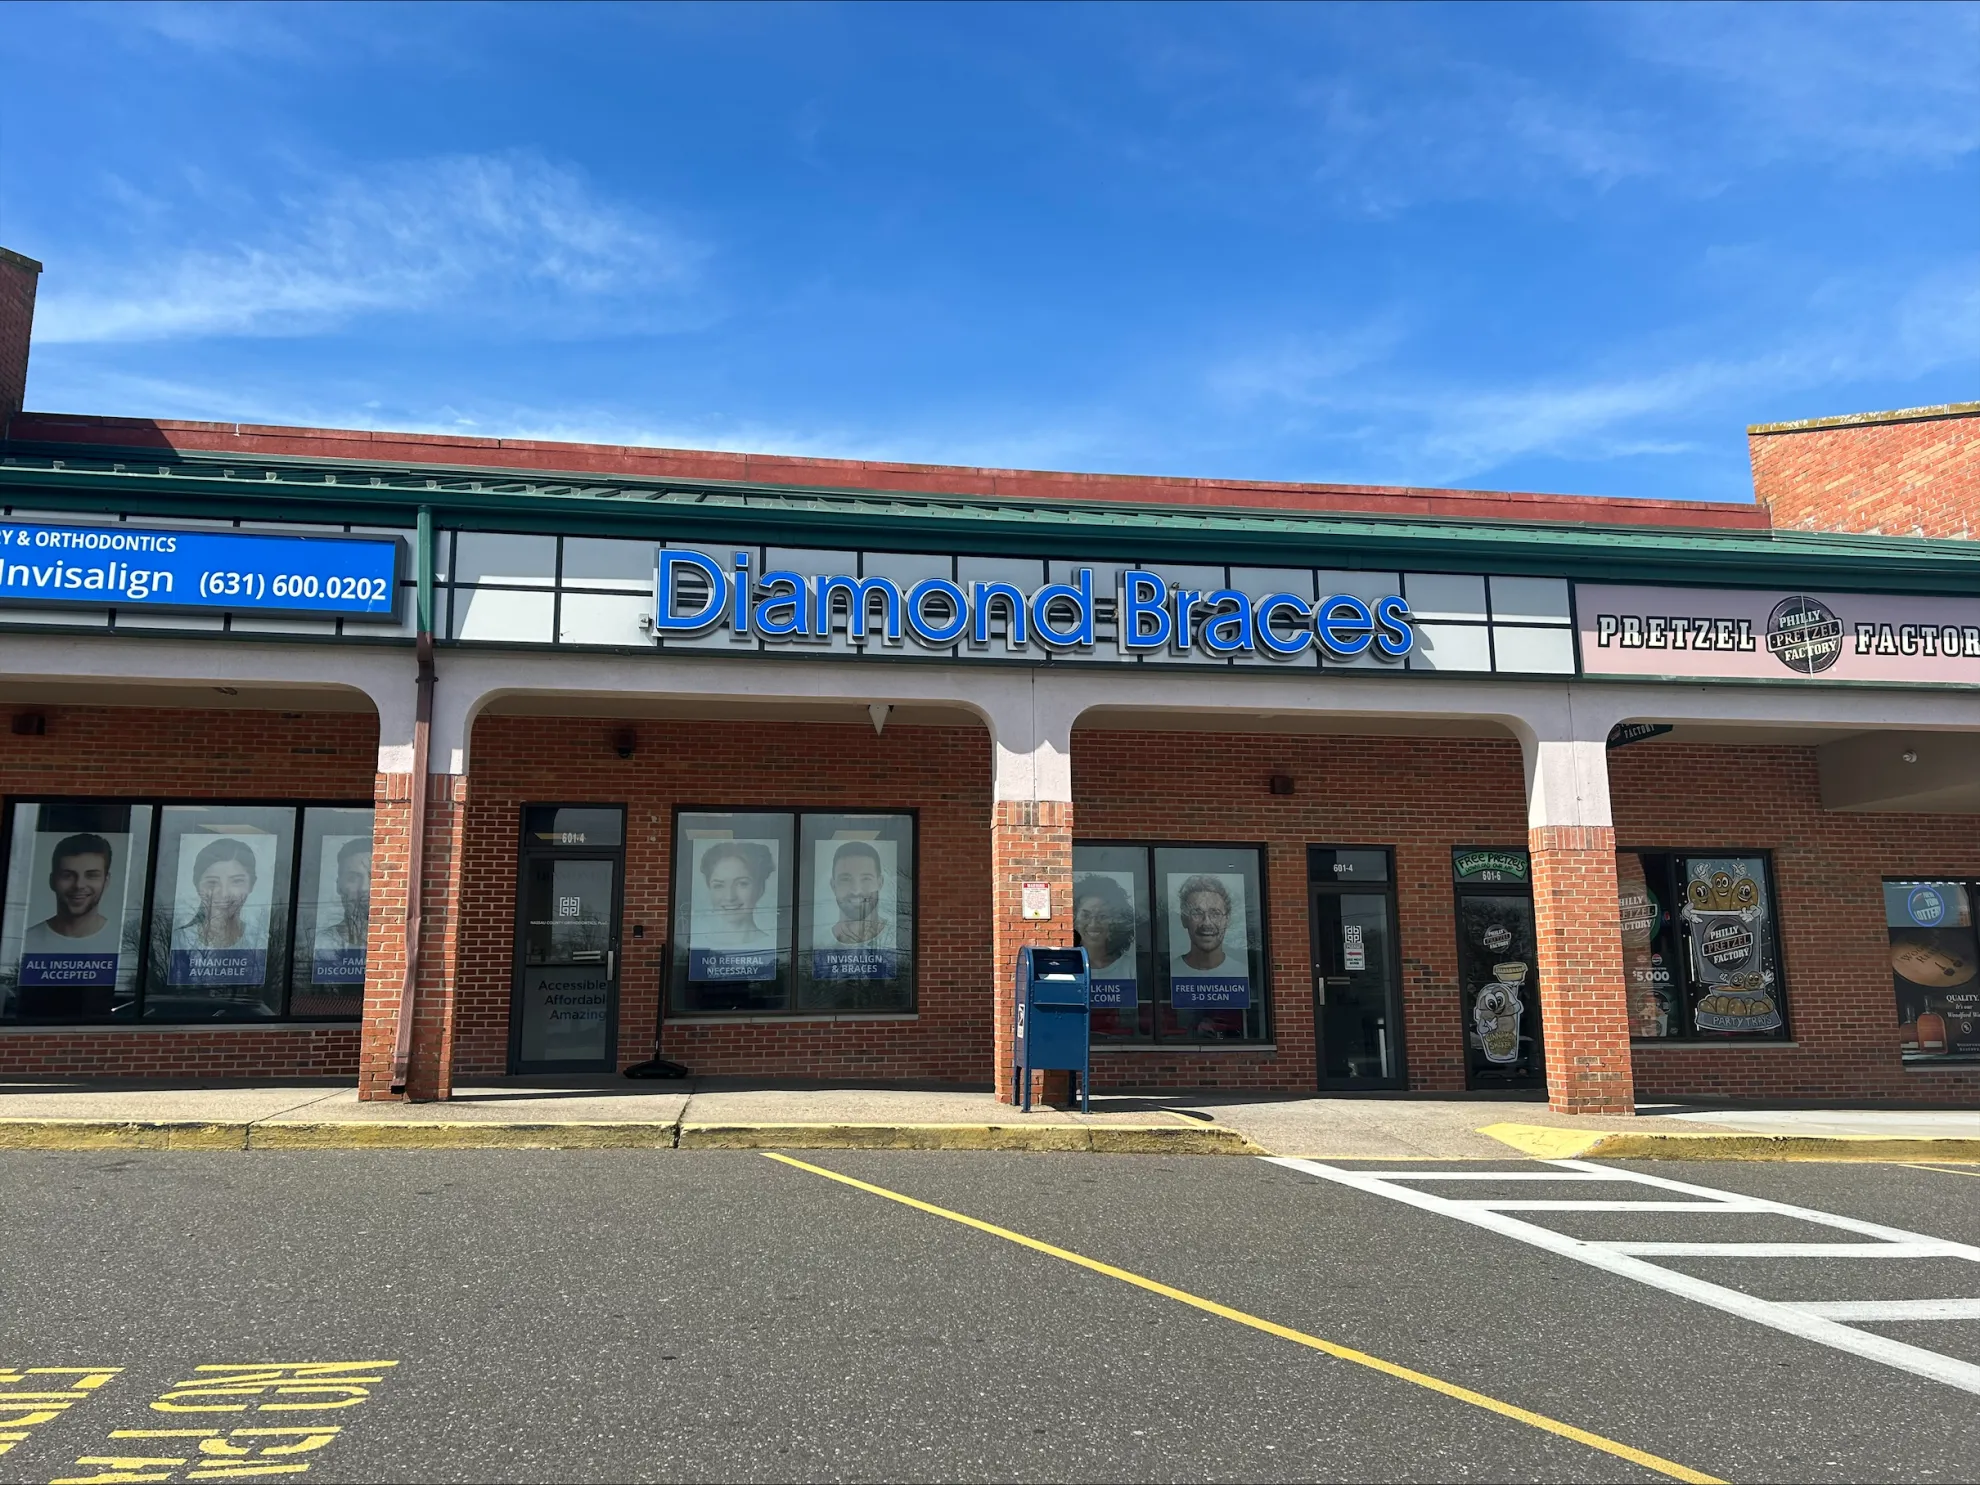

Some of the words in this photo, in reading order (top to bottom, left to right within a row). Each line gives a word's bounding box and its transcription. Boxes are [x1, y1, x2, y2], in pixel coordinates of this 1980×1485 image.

[16, 530, 31, 546] &
[35, 531, 177, 553] ORTHODONTICS
[0, 558, 174, 599] Invisalign
[200, 571, 265, 600] (631)
[272, 574, 387, 601] 600.0202
[656, 547, 1095, 650] Diamond
[1123, 569, 1415, 657] Braces
[1779, 610, 1821, 628] PHILLY
[1597, 615, 1756, 652] PRETZEL
[1776, 623, 1837, 647] PRETZEL
[1855, 622, 1980, 657] FACTOR
[1784, 640, 1837, 661] FACTORY
[1623, 723, 1655, 739] FACTORY
[1333, 863, 1353, 873] 601-4
[1482, 870, 1501, 881] 601-6
[1619, 895, 1644, 906] HILLY
[1622, 906, 1653, 919] ETZEL
[1620, 919, 1652, 931] ACTORY
[1710, 924, 1739, 940] PHILLY
[1707, 935, 1750, 953] PRETZEL
[702, 956, 717, 965] NO
[719, 956, 764, 965] REFERRAL
[827, 954, 883, 963] INVISALIGN
[1713, 947, 1750, 964] FACTORY
[26, 960, 49, 970] ALL
[50, 960, 113, 970] INSURANCE
[189, 957, 248, 967] FINANCING
[342, 957, 364, 966] FAM
[189, 967, 245, 976] AVAILABLE
[706, 967, 759, 975] NECESSARY
[831, 964, 839, 973] &
[841, 964, 878, 973] BRACES
[40, 970, 97, 980] ACCEPTED
[1632, 970, 1670, 982] $5,000
[538, 979, 607, 990] Accessible
[1090, 984, 1120, 993] LK-INS
[1175, 984, 1194, 993] FREE
[1196, 984, 1245, 993] INVISALIGN
[544, 994, 606, 1005] Affordabl
[1090, 994, 1121, 1002] COME
[1191, 993, 1205, 1001] 3-D
[1207, 993, 1230, 1001] SCAN
[1946, 994, 1980, 1003] QUALITY.
[549, 1009, 607, 1021] Amazing
[1713, 1016, 1743, 1027] PARTY
[1744, 1015, 1772, 1026] TRAYS
